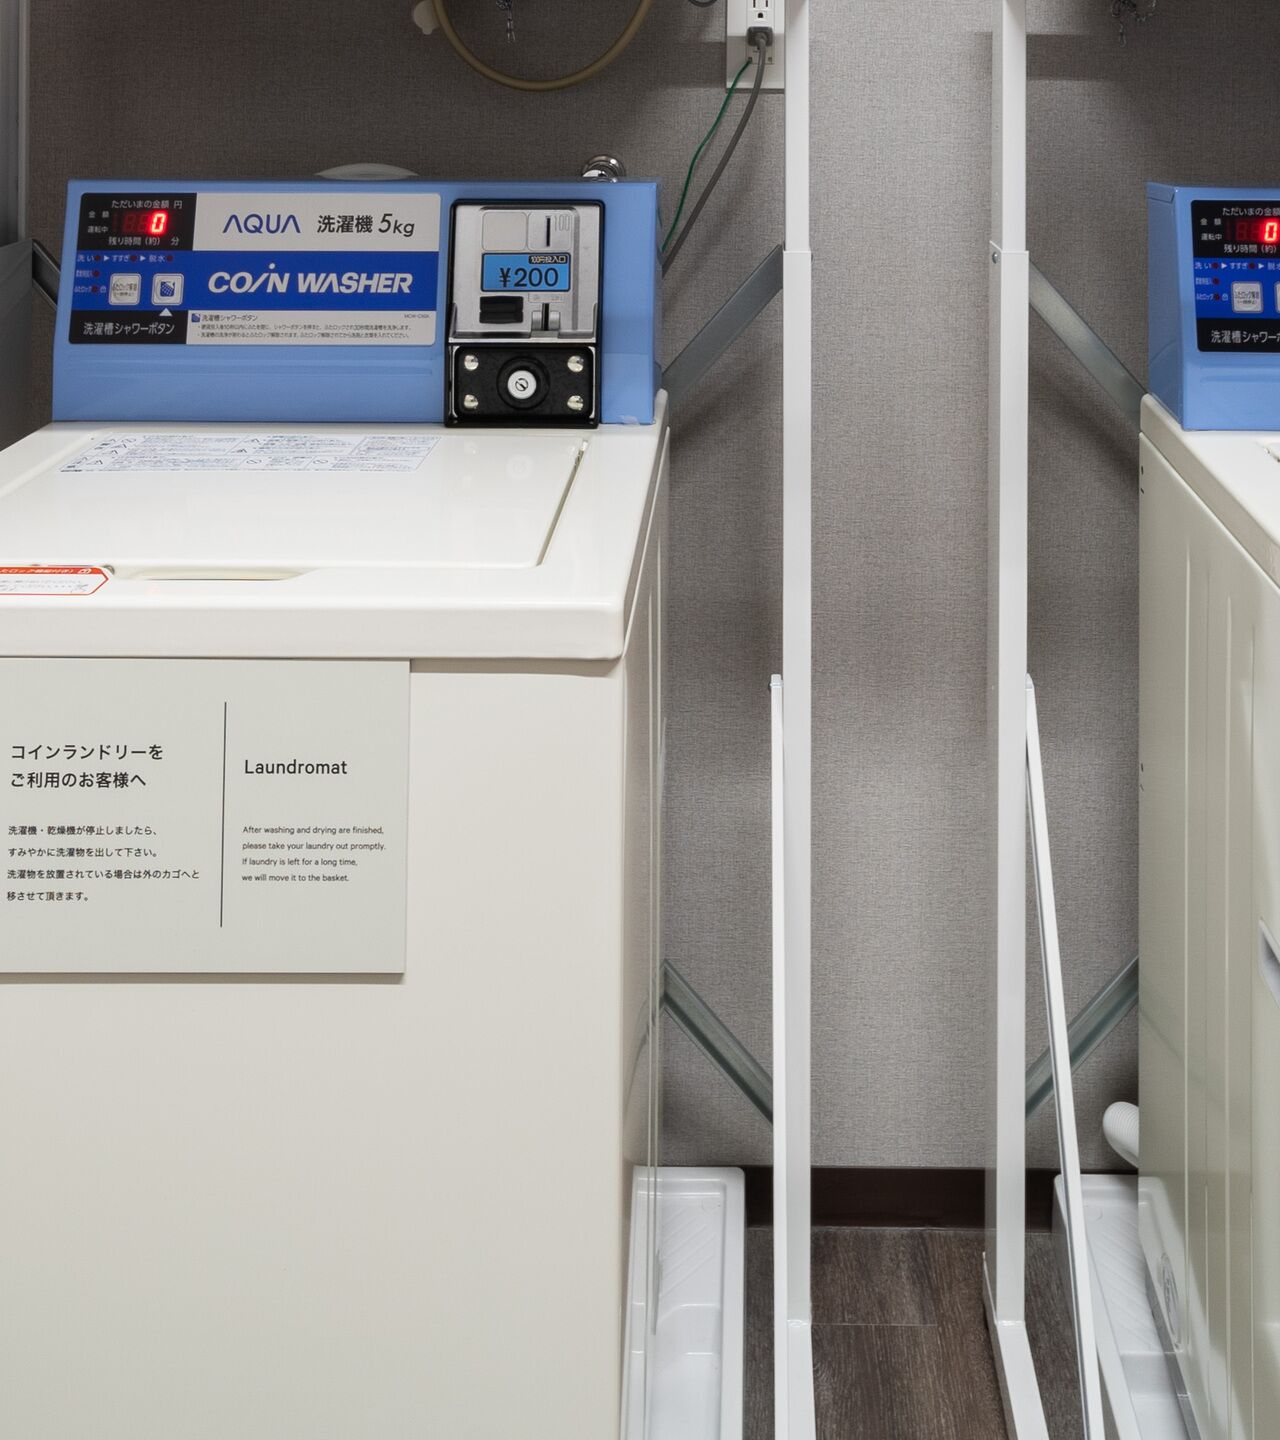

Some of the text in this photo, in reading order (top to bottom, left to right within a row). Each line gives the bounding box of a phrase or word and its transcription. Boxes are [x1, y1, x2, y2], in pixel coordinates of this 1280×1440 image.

[111, 199, 183, 210] ただいまの金額 円
[150, 212, 167, 234] 0
[221, 212, 416, 238] AQUA 洗濯機 5kg
[1263, 222, 1279, 242] 0
[170, 236, 180, 247] 分
[207, 262, 414, 294] COIN WASHER
[498, 266, 559, 289] ¥200
[201, 313, 258, 323] 洗濯槽シャワーボタン
[82, 321, 175, 336] 洗濯槽シャワーボタン
[11, 743, 164, 761] コインランドリーを
[244, 758, 348, 775] Laundromat
[10, 771, 147, 789] ご利用のお客様へ
[7, 825, 157, 836] 洗濯機・乾燥機が停止しましたら、
[242, 825, 262, 834] After
[263, 825, 295, 836] washing
[296, 825, 311, 834] and
[312, 826, 337, 836] drying
[352, 825, 384, 835] finished,
[7, 847, 157, 858] すみやかに洗濯物を出して下さい。
[242, 841, 386, 852] please take your laundry out promptly.
[241, 857, 248, 865] If
[248, 857, 278, 867] laundry
[279, 857, 286, 866] is
[287, 857, 300, 866] left
[301, 857, 313, 866] for
[320, 858, 338, 868] long
[338, 858, 358, 866] time,
[6, 868, 200, 880] 洗濯物を放置されている場合は外のカゴへと
[254, 873, 267, 881] will
[290, 874, 297, 882] it
[297, 874, 307, 882] to
[307, 874, 321, 882] the
[322, 873, 349, 882] basket.
[6, 890, 89, 902] 移させて頂きます。
